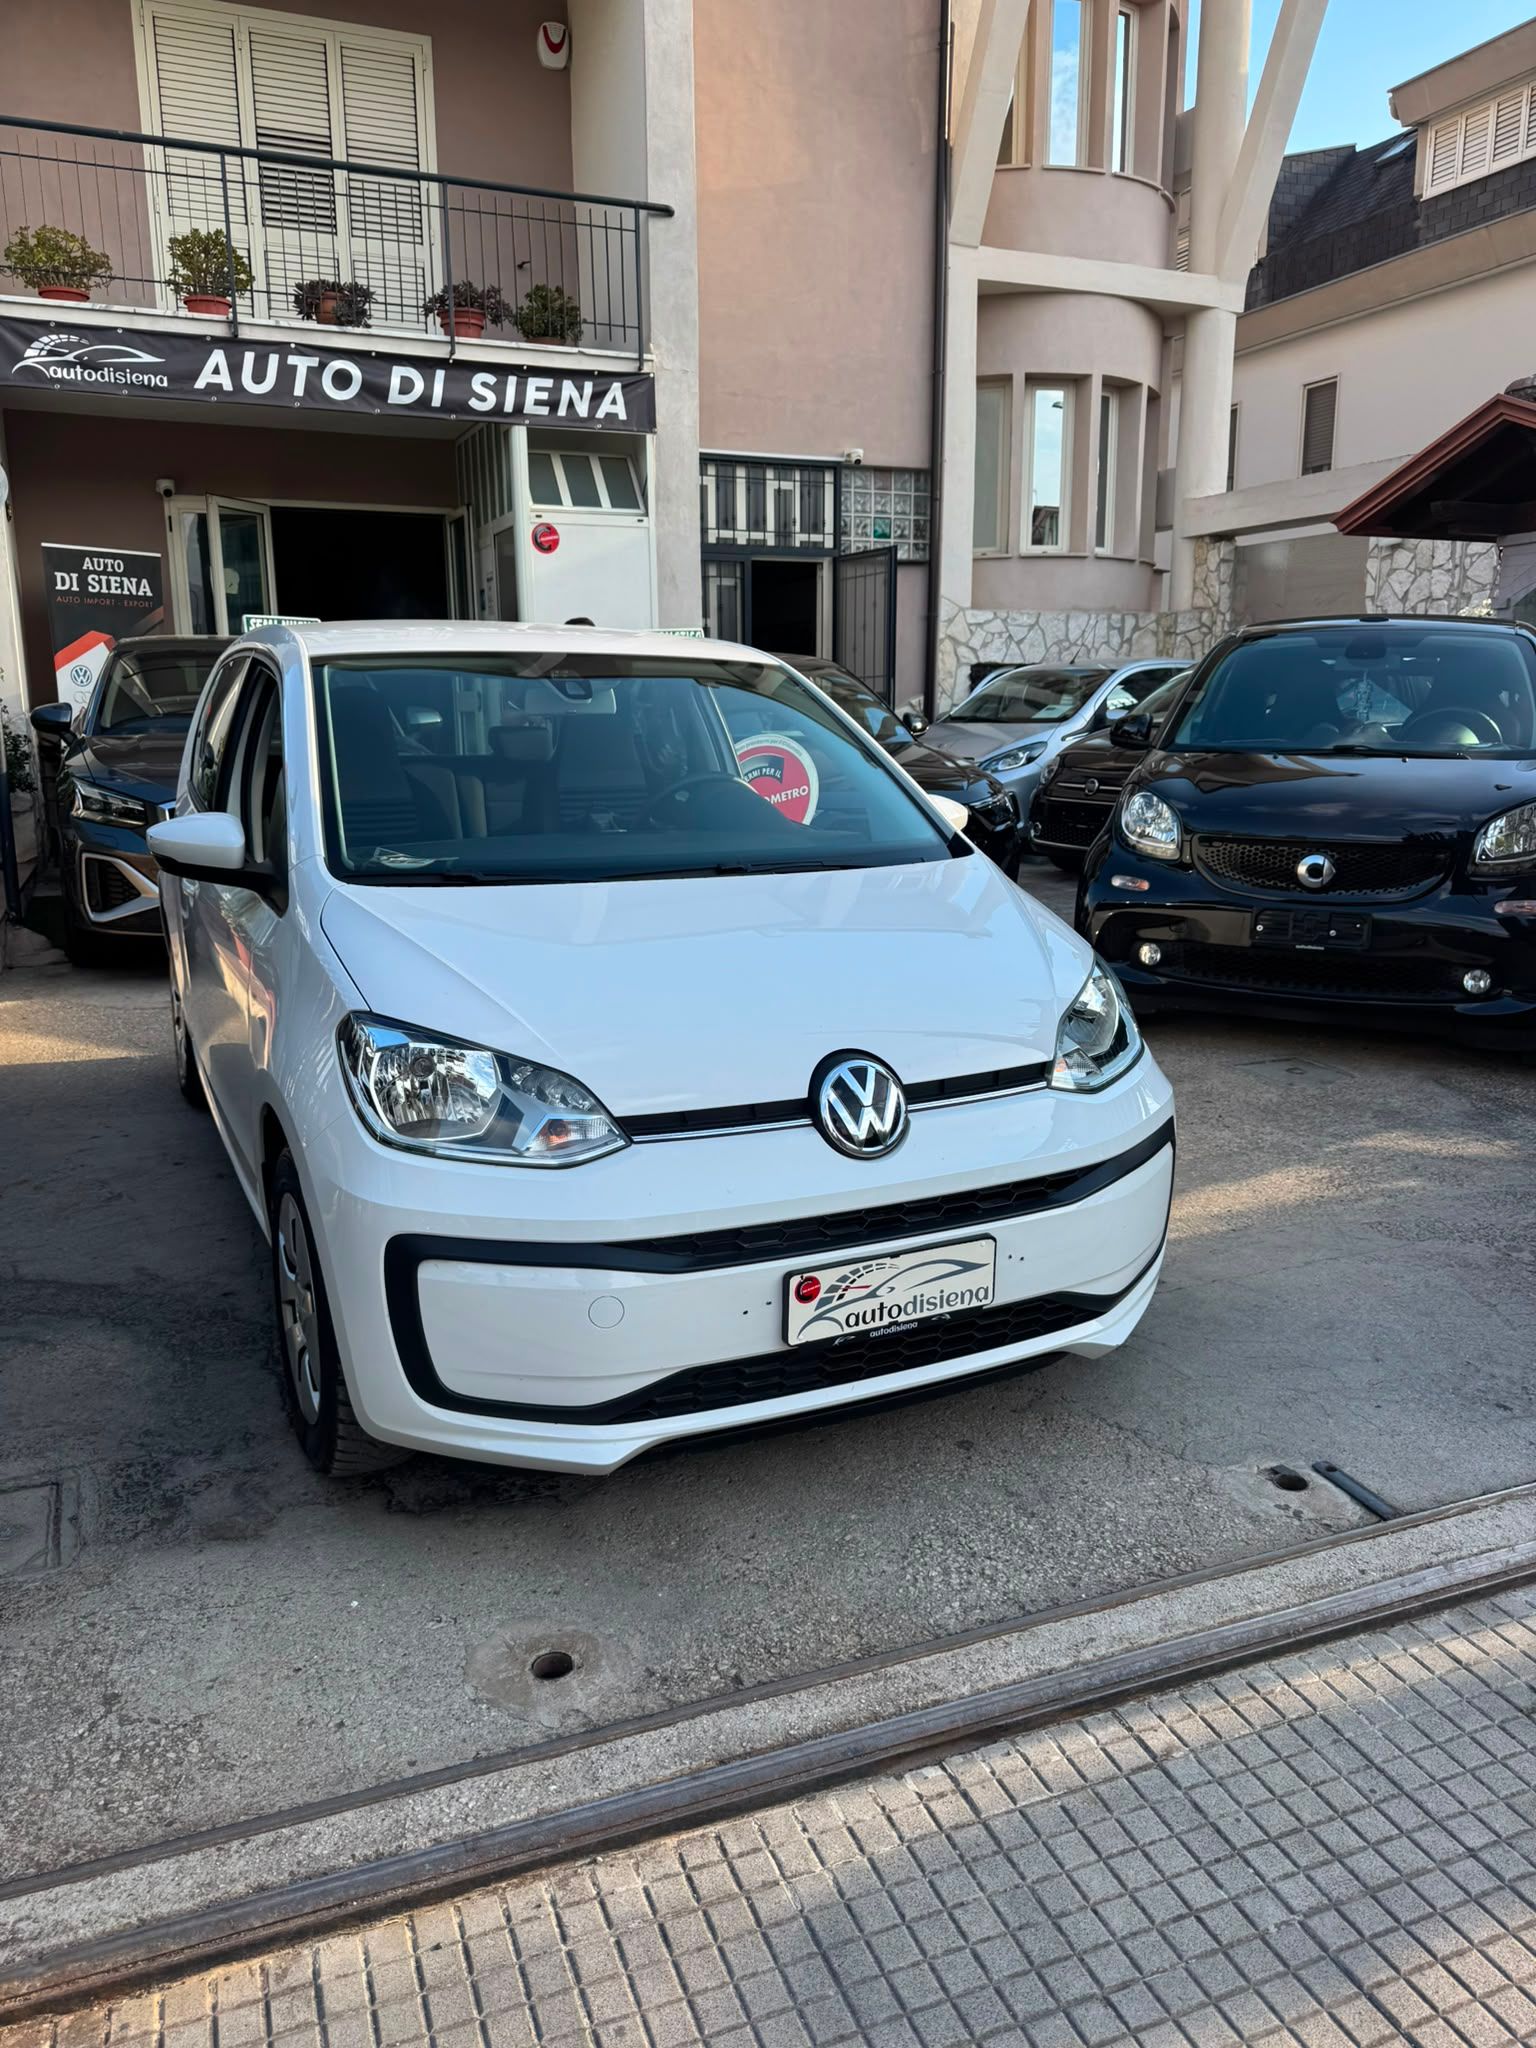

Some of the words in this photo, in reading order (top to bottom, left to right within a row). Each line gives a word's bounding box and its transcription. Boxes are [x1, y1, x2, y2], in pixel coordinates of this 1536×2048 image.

[50, 364, 168, 388] autodisiena
[194, 349, 363, 401] AUTO
[388, 365, 444, 407] DI
[468, 373, 628, 421] SIENA
[82, 556, 124, 573] AUTO
[54, 571, 80, 592] DI
[87, 574, 153, 597] SIENA
[56, 595, 81, 604] AUTO
[84, 597, 115, 606] IMPORT
[124, 599, 153, 608] EXPORT
[744, 769, 761, 782] ERMI
[762, 767, 775, 776] PER
[845, 1286, 989, 1328] autodisiena
[869, 1321, 918, 1338] autodisiena
